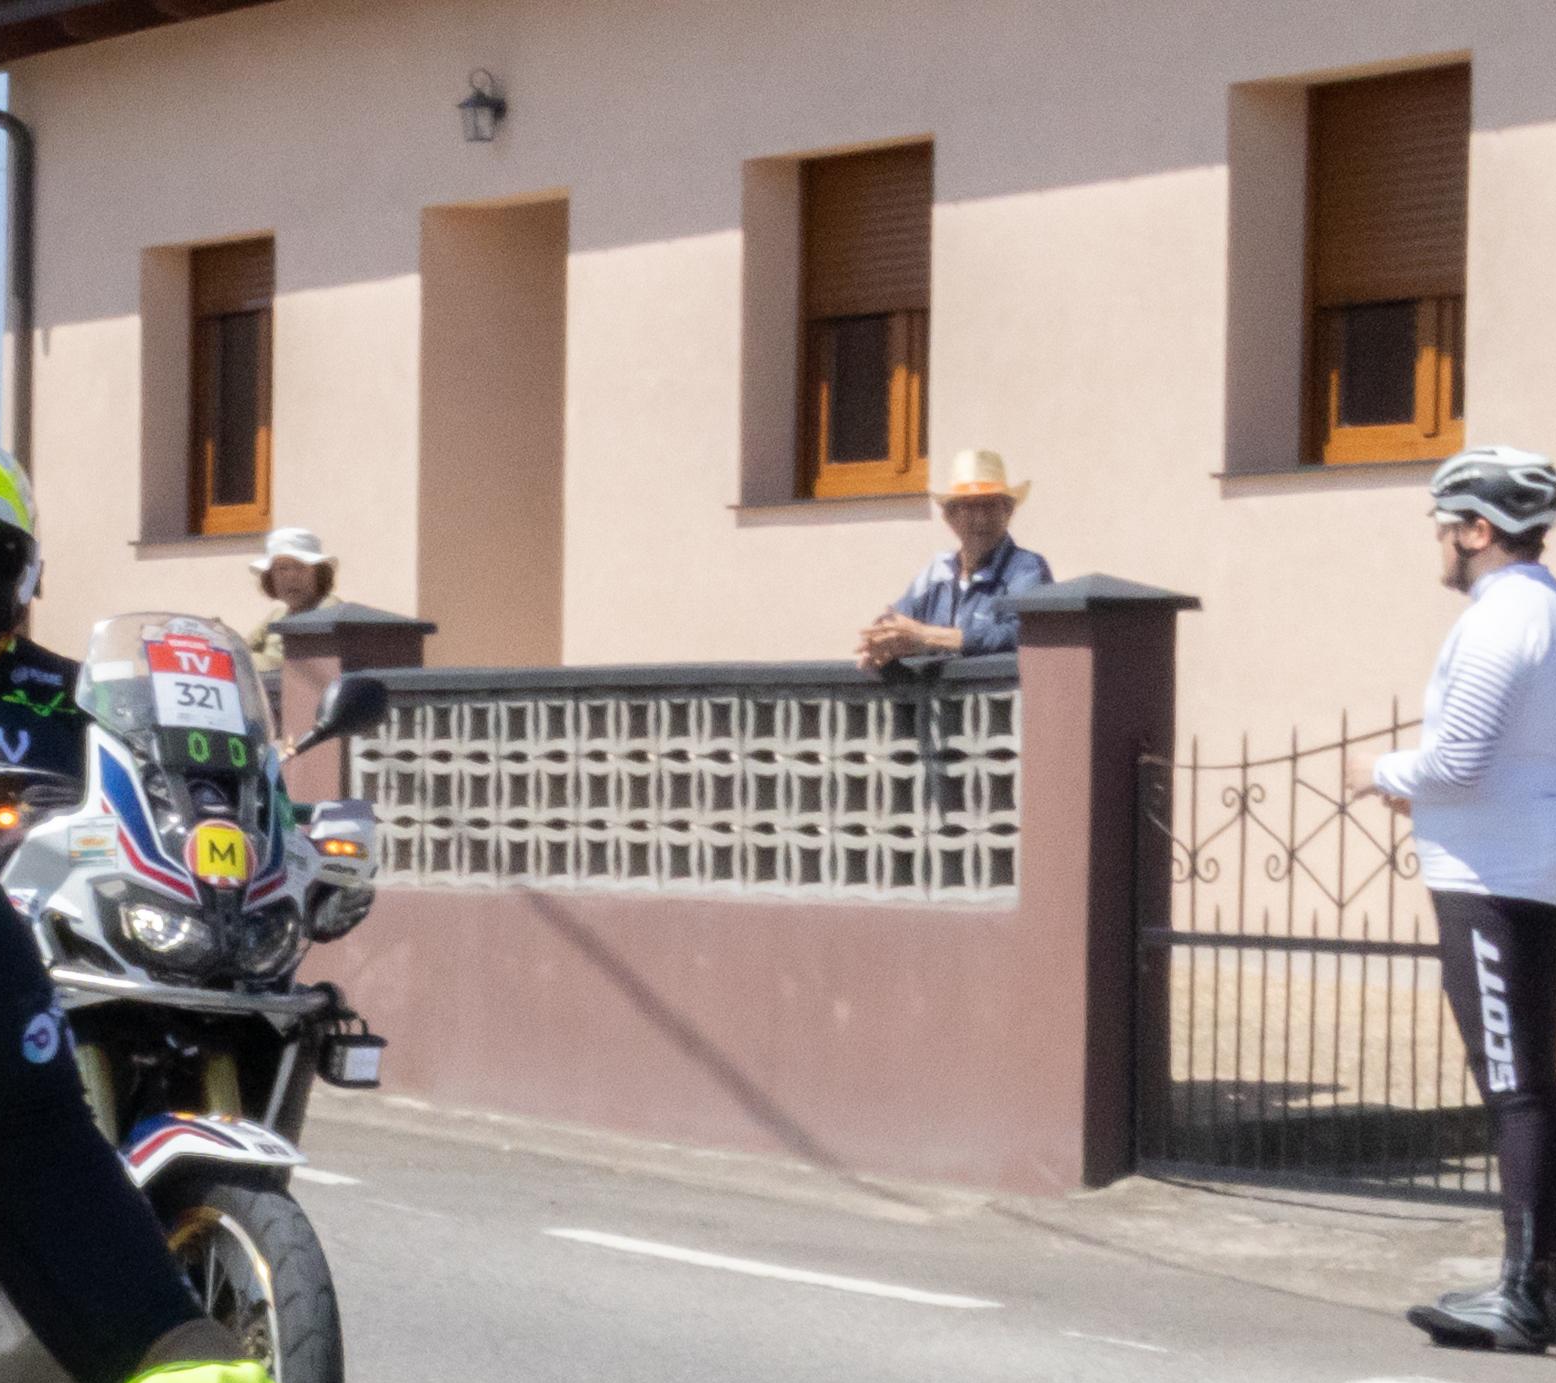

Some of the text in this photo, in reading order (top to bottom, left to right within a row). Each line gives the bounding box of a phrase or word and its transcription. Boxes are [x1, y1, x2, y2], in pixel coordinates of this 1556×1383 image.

[174, 649, 211, 674] TV
[174, 682, 224, 711] 321
[209, 840, 237, 867] M
[1471, 928, 1519, 1094] SCOTT
